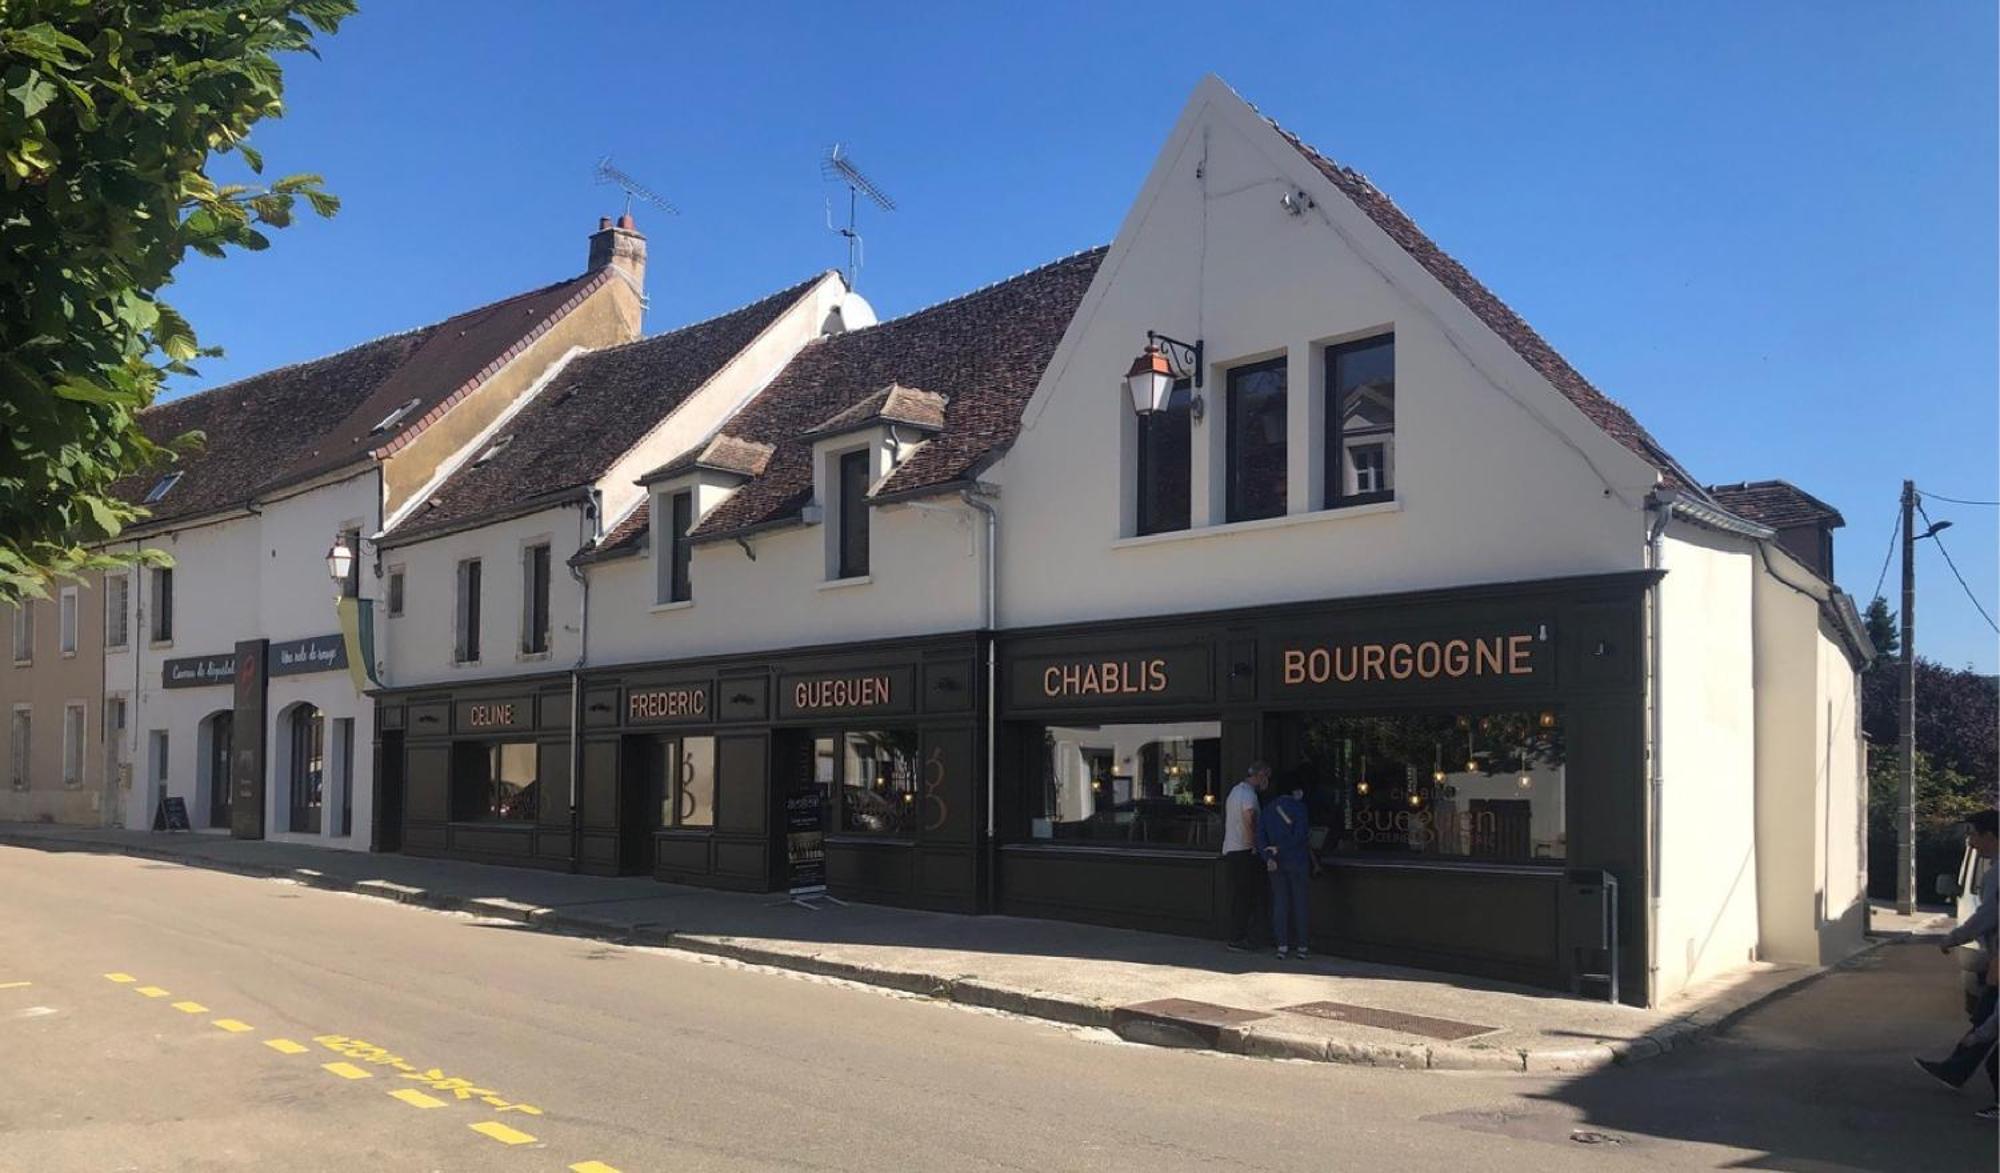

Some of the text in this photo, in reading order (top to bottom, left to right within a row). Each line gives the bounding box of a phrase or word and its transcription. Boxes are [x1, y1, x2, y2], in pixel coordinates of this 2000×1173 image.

[1284, 635, 1533, 685] BOURGOGNE
[795, 677, 890, 709] GUEGUEN
[1043, 660, 1167, 698] CHABLIS
[471, 704, 513, 728] CELINE
[629, 690, 705, 719] FREDERIC
